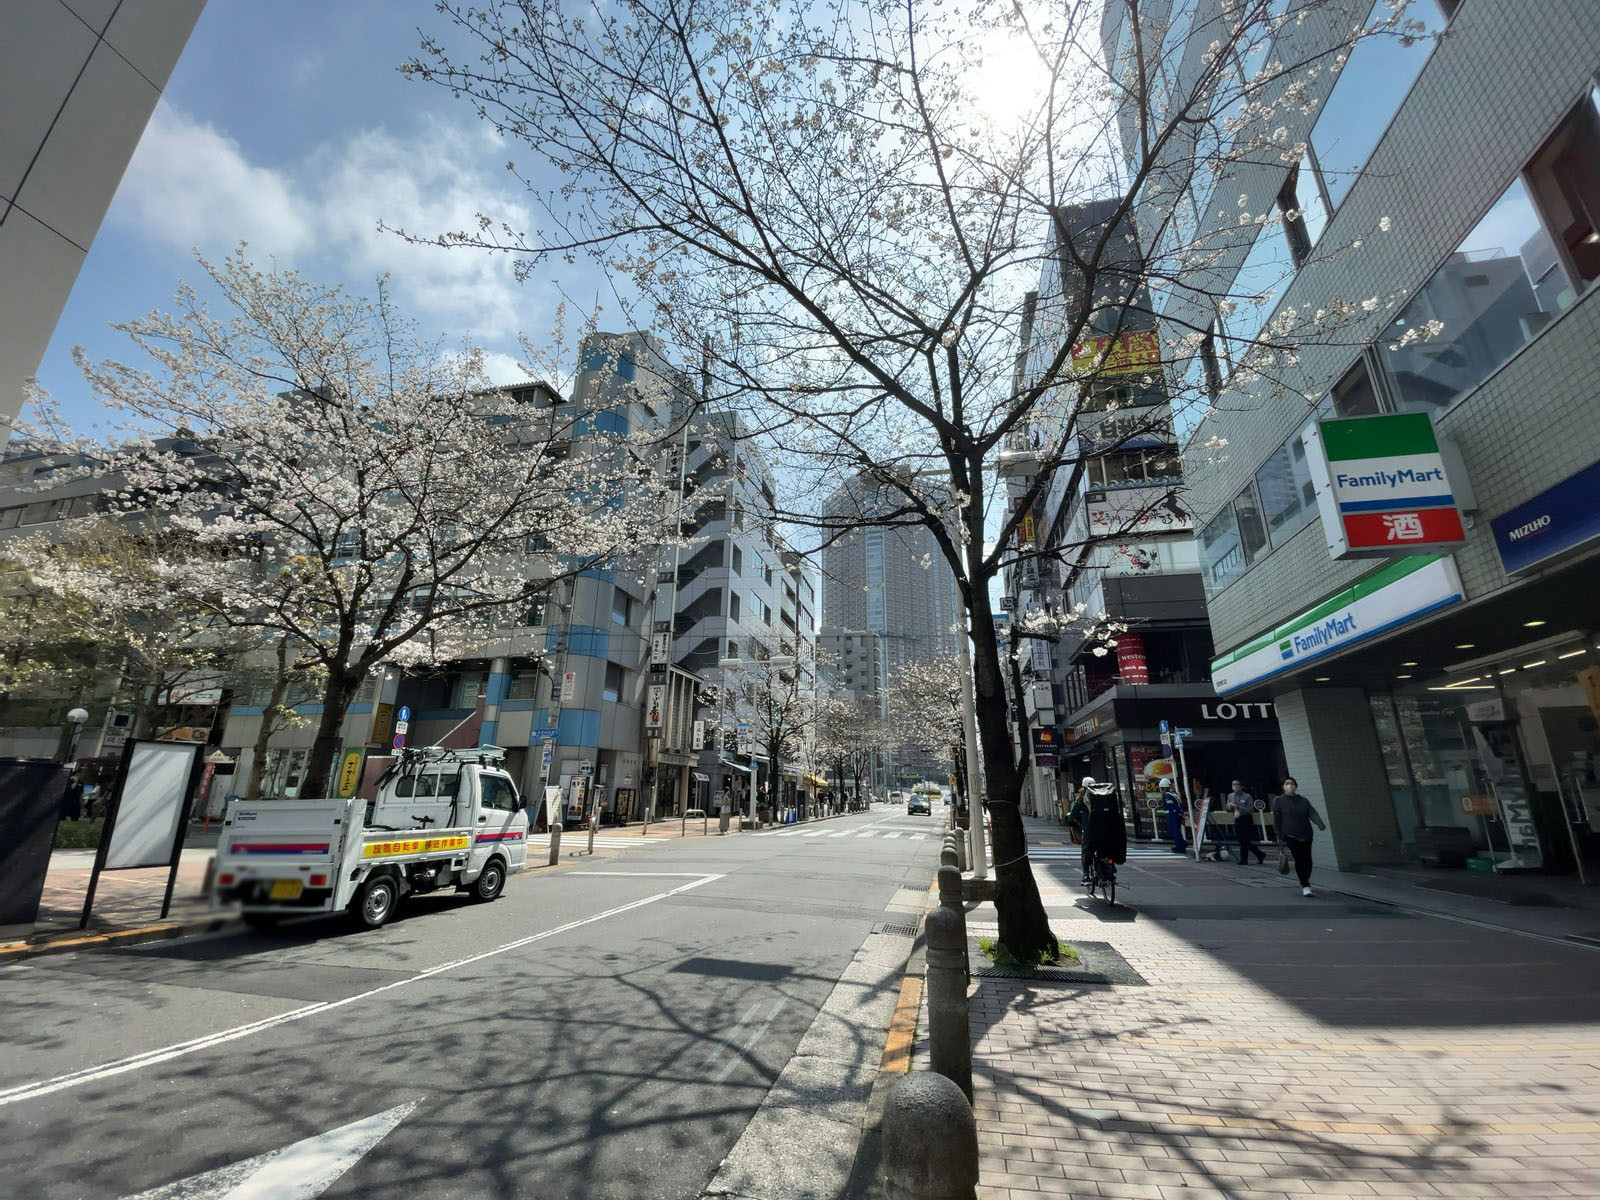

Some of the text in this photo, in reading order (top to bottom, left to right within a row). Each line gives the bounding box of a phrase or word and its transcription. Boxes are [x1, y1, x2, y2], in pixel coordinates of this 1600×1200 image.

[1336, 468, 1444, 488] FamilyMart
[1382, 513, 1424, 540] 酒
[1509, 515, 1551, 542] MIZUHO
[1294, 612, 1357, 654] FamilyMart
[1201, 703, 1279, 719] LOTT
[373, 842, 420, 854] 放置自転車
